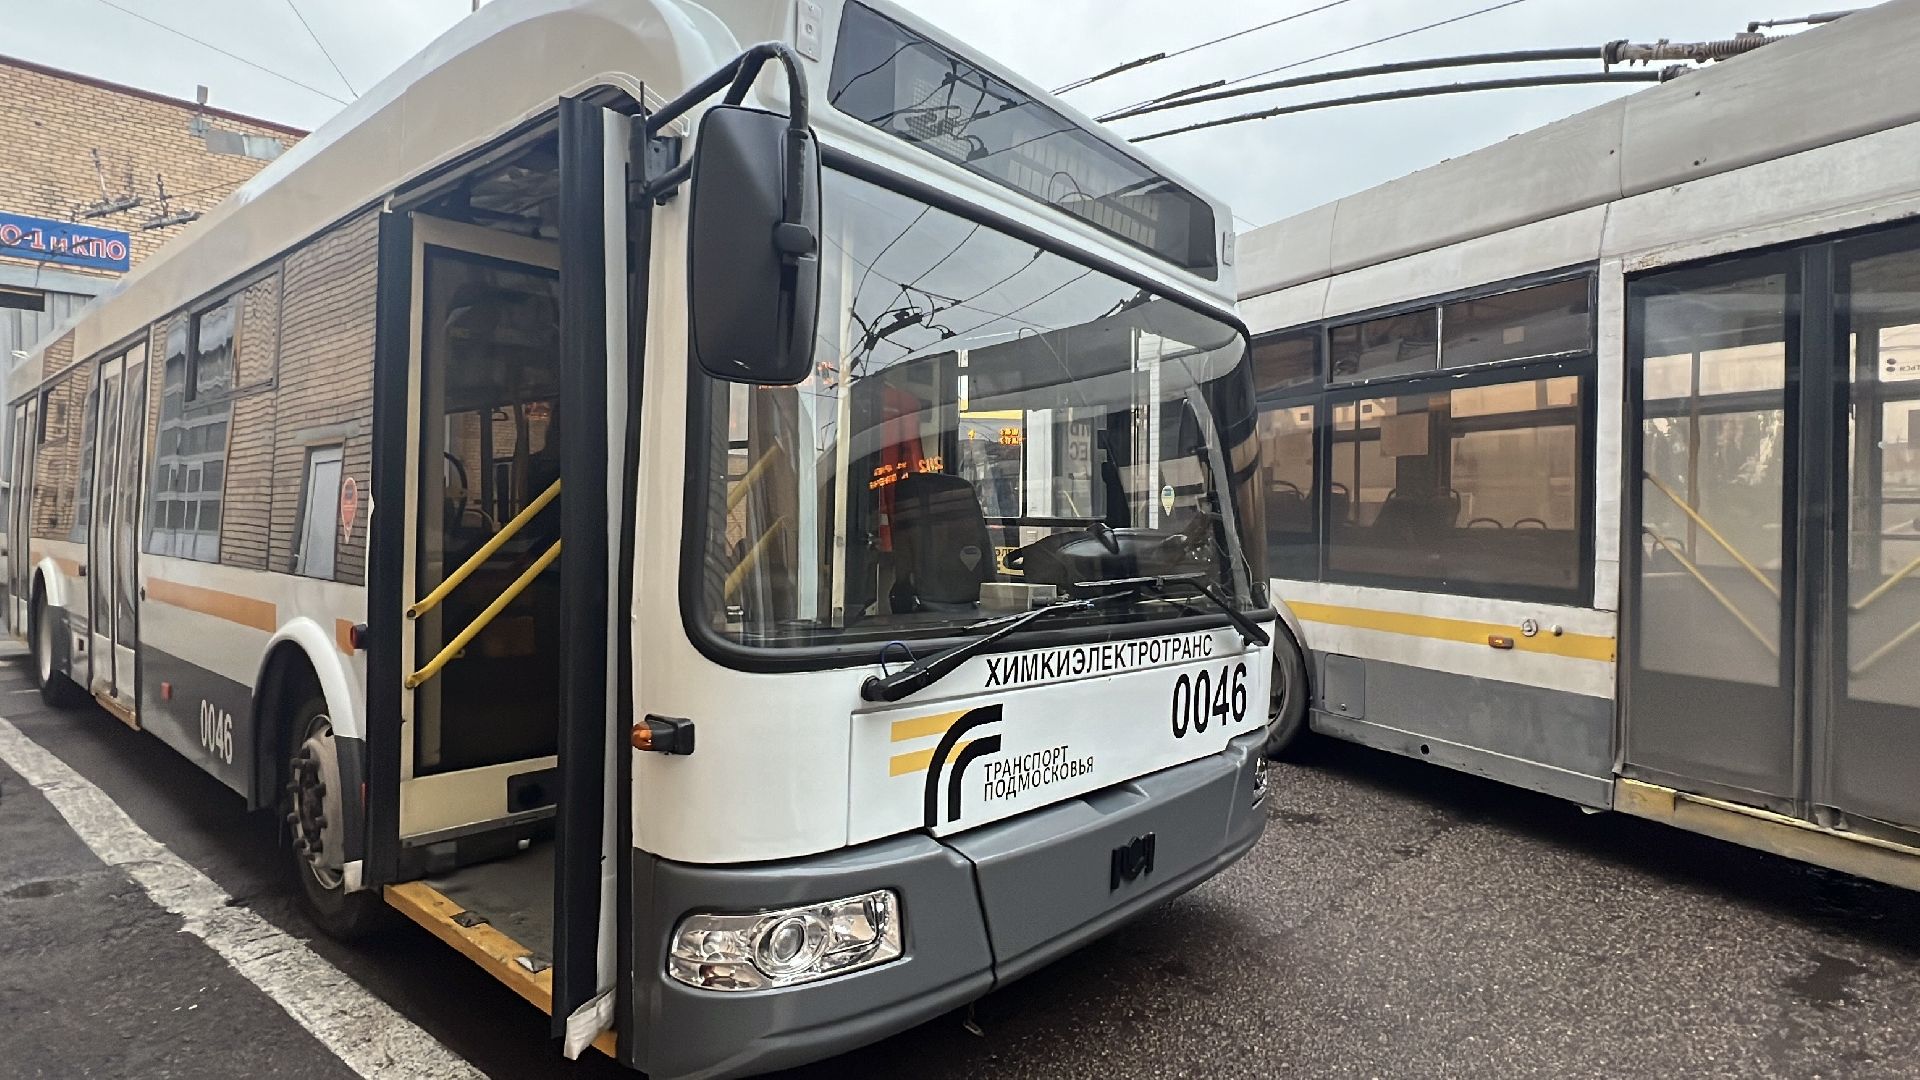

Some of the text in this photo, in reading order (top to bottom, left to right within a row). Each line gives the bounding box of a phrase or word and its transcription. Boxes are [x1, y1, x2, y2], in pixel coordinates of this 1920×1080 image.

[0, 224, 45, 250] О-1
[72, 234, 127, 260] КПО
[984, 634, 1213, 688] ХИМКИЭЛЕКТРОТРАНС
[1172, 662, 1248, 739] 0046
[200, 699, 233, 765] 0046
[984, 745, 1069, 782] ТРАНСПОРТ
[984, 756, 1094, 802] ПОДМОСКОВЬЯ
